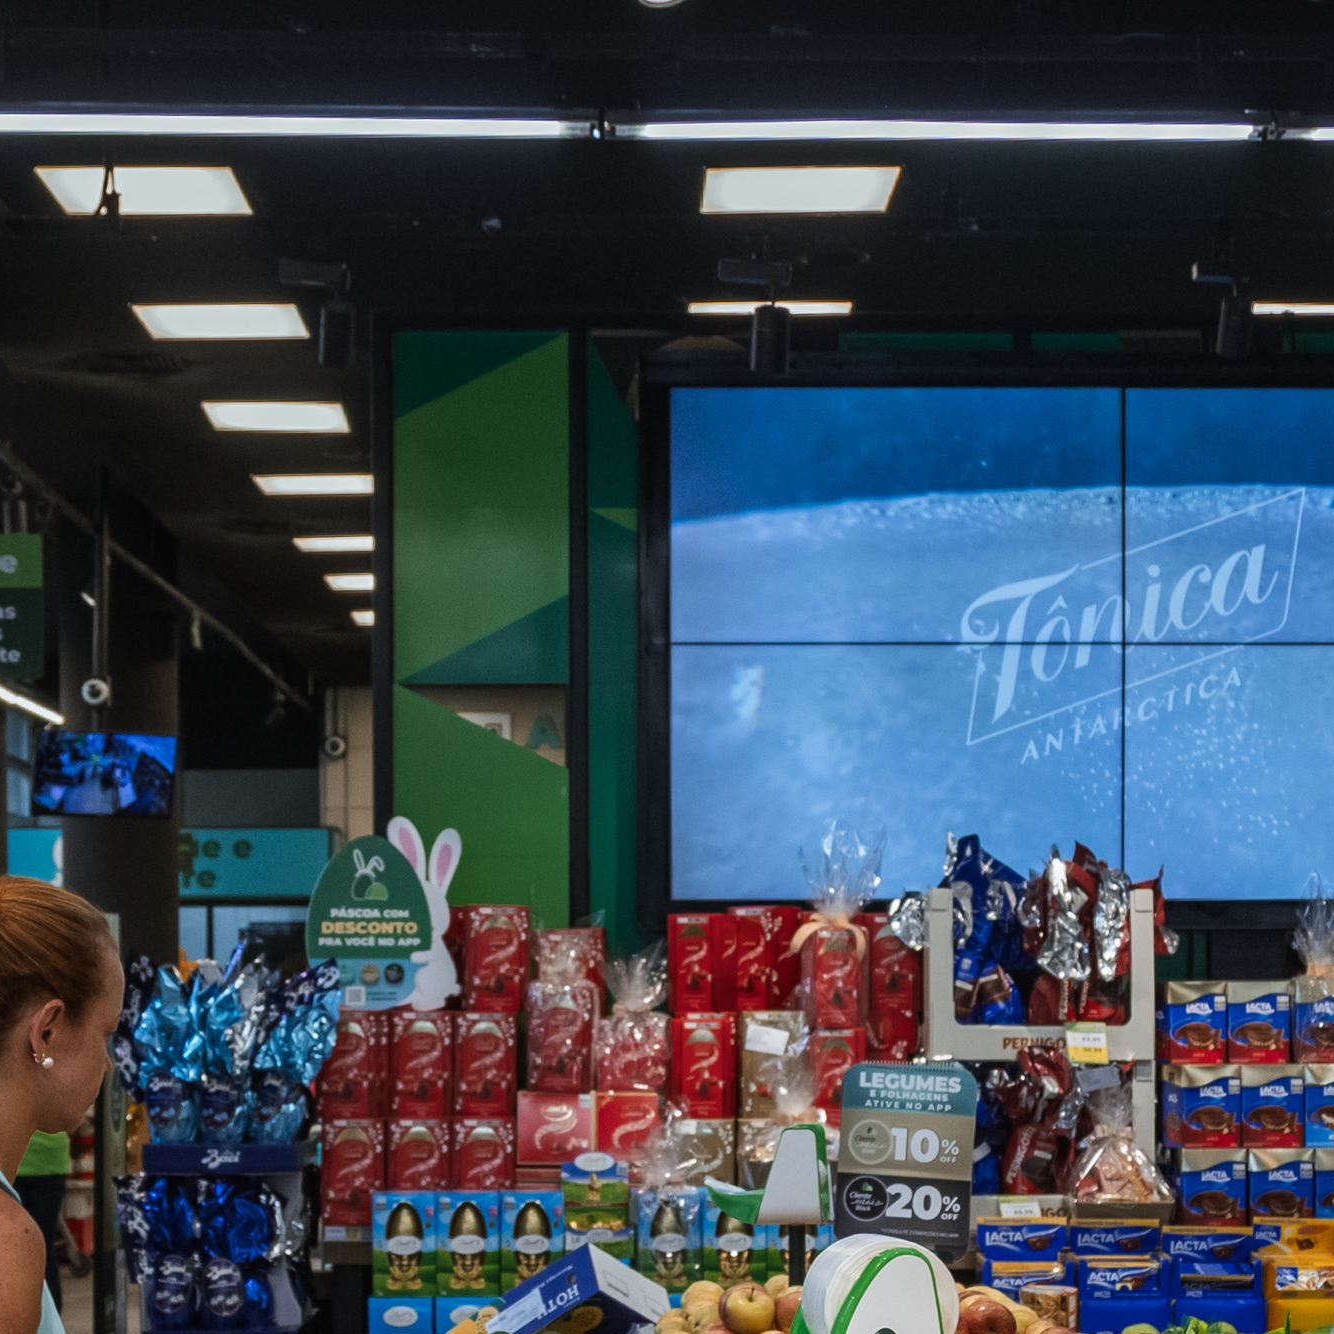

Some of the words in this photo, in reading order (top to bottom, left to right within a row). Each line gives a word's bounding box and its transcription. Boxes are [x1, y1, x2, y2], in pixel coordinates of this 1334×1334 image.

[959, 543, 1279, 724] Tônica
[1020, 666, 1242, 765] ANTARCTICA
[330, 906, 381, 918] PÁSCOA
[383, 910, 409, 918] COM
[321, 922, 418, 934] DESCONTO
[319, 938, 342, 946] PRA
[346, 936, 374, 946] VOCÊ
[378, 938, 395, 946] NO
[397, 938, 420, 946] APP
[1186, 1002, 1213, 1014] LACTA
[1246, 1002, 1275, 1014] LACTA
[1003, 1037, 1066, 1049] PERNIGO
[859, 1071, 962, 1093] LEGUMES
[880, 1090, 949, 1101] FOLHAGENS
[1200, 1086, 1227, 1097] LACTA
[1260, 1086, 1289, 1097] LACTA
[865, 1100, 900, 1109] ATIVE
[906, 1101, 922, 1110] NO
[928, 1103, 952, 1112] APP
[201, 1149, 240, 1169] Baci
[1006, 1125, 1037, 1184] PERNIGOTTI
[1201, 1171, 1231, 1182] LACTA
[1269, 1170, 1298, 1182] LACTA
[985, 1231, 1024, 1246] LACTA
[1077, 1231, 1115, 1246] LACTA
[1170, 1239, 1209, 1254] LACTA
[1087, 1270, 1119, 1285] ACTA
